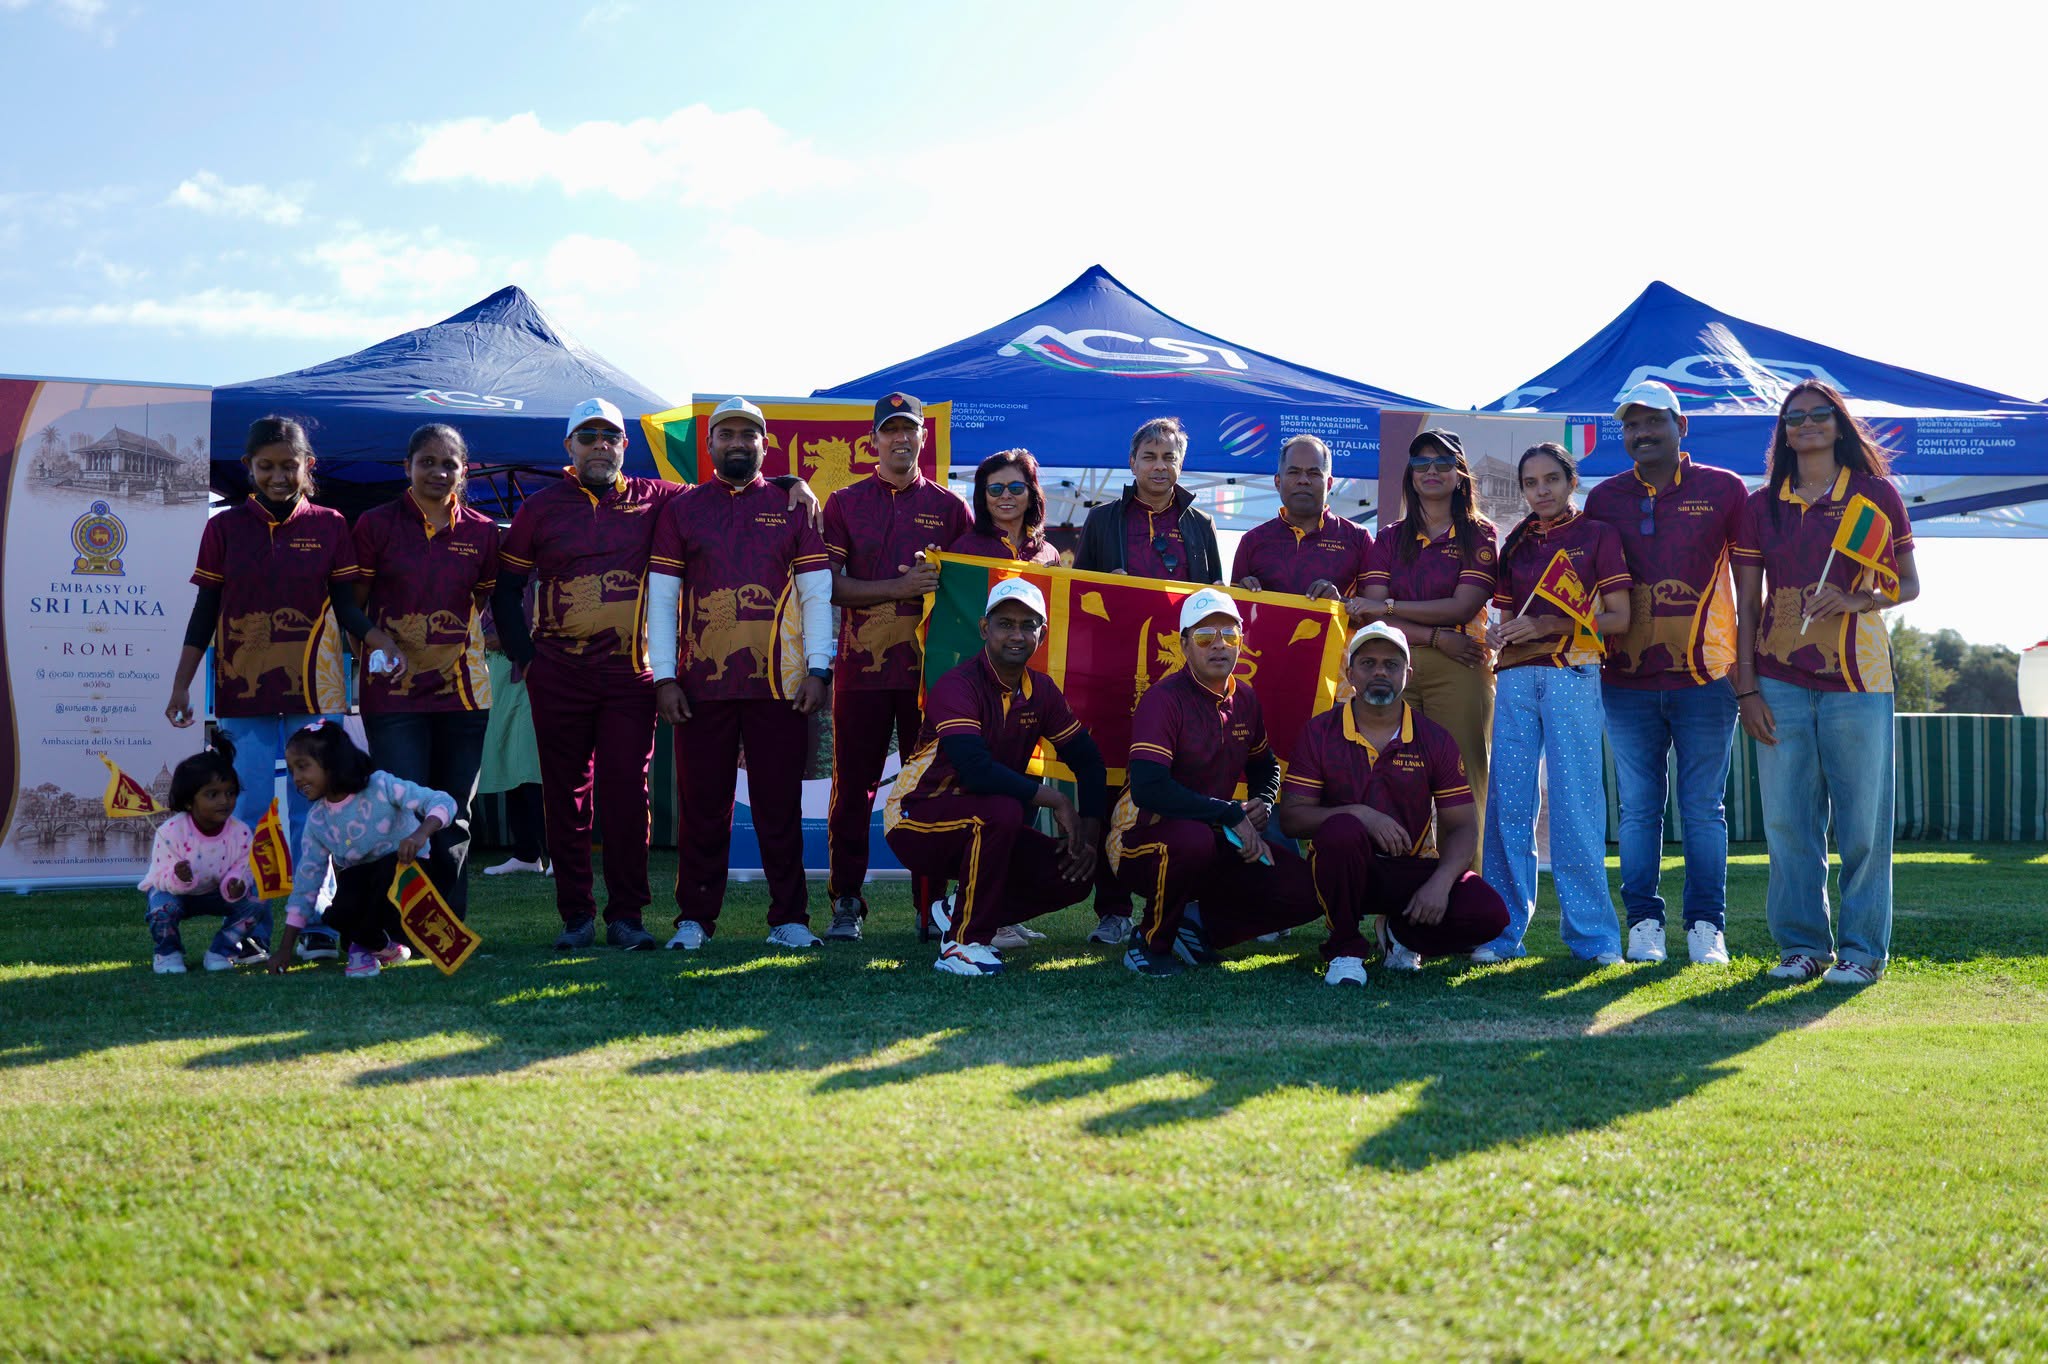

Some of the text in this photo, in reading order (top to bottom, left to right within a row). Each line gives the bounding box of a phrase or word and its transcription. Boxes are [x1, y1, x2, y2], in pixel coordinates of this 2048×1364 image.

[997, 325, 1249, 369] ACSI
[406, 389, 524, 410] ACSI
[1280, 426, 1326, 434] riconosciuto
[1319, 422, 1369, 430] PARALIMPICA
[1916, 439, 2016, 447] COMITATO ITALIANO
[1917, 447, 1984, 455] PARALIMPICO
[51, 582, 147, 595] EMBASSY OF
[30, 597, 165, 616] SRI LANKA
[63, 642, 134, 657] ROME
[41, 737, 152, 745] Ambasciata dello Sri Lanka
[85, 748, 108, 756] Roma
